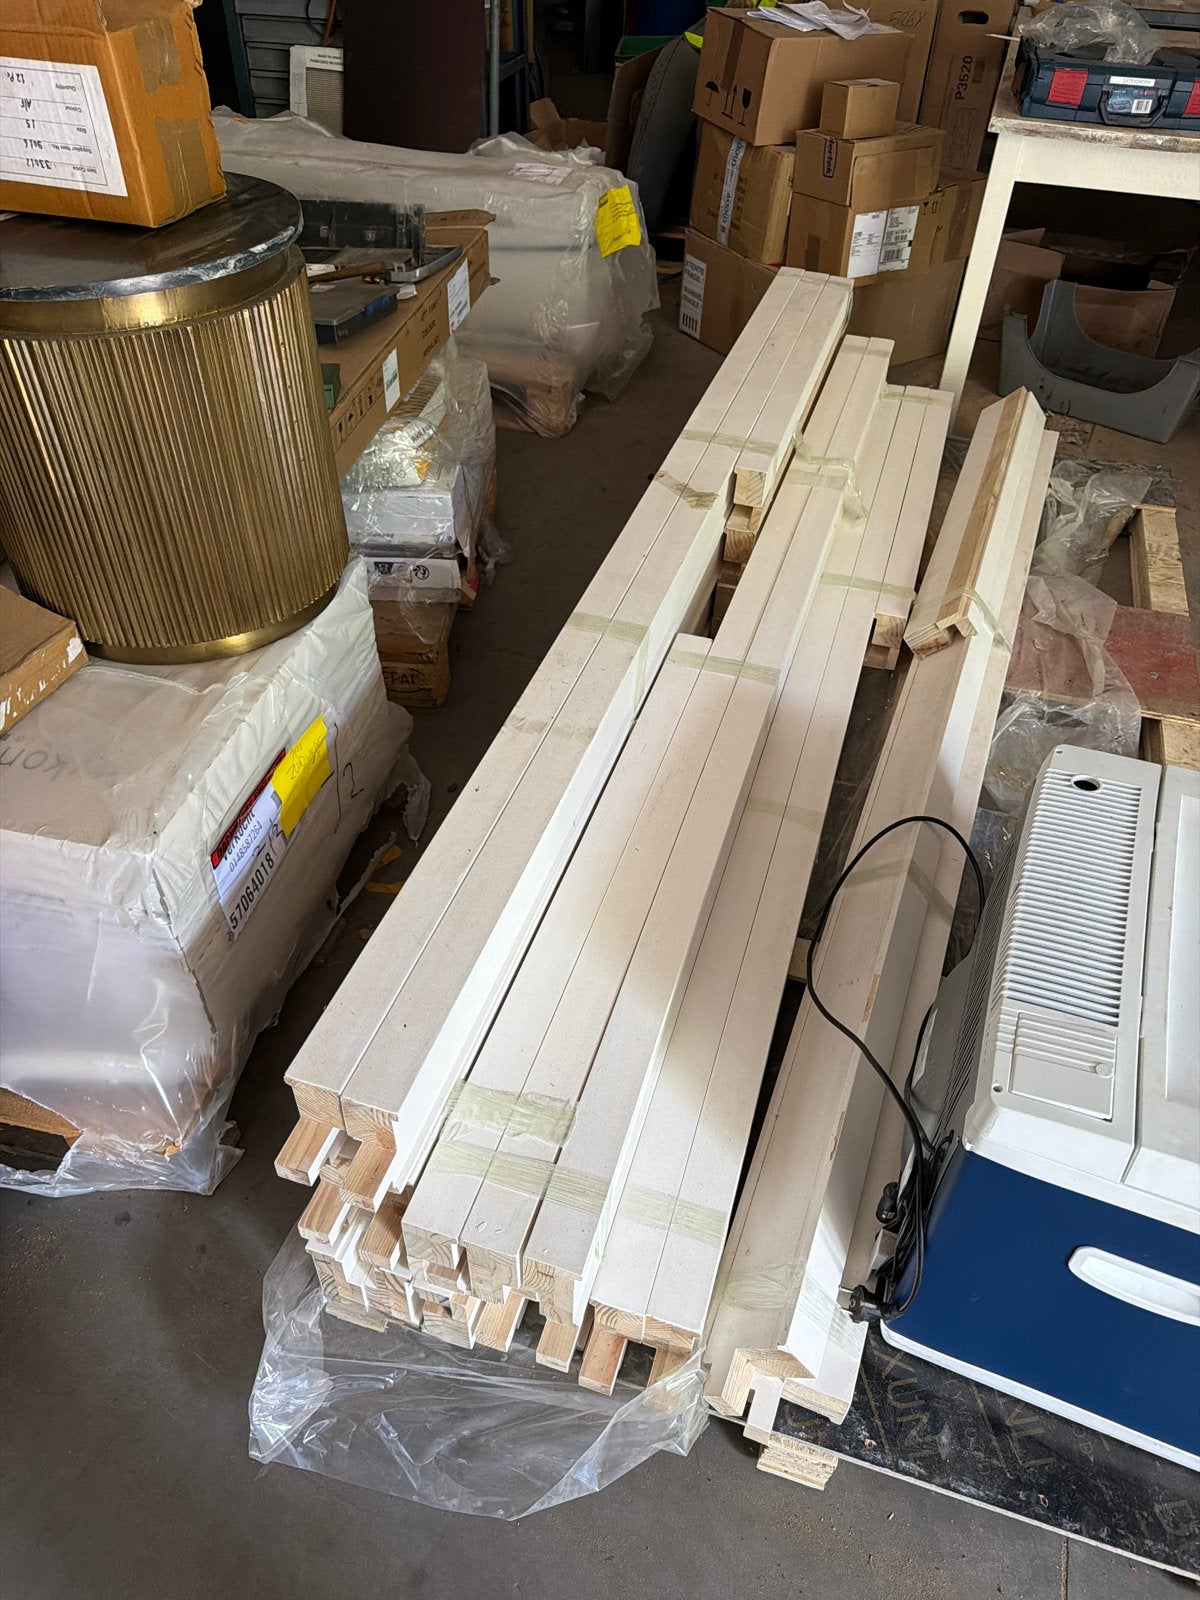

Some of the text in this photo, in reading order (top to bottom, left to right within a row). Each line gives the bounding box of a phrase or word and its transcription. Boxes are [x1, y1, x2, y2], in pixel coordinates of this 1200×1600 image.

[954, 54, 974, 101] P3520
[55, 82, 77, 92] Quantity
[25, 118, 36, 129] 15
[26, 158, 52, 170] 33012
[229, 854, 275, 930] 57064018
